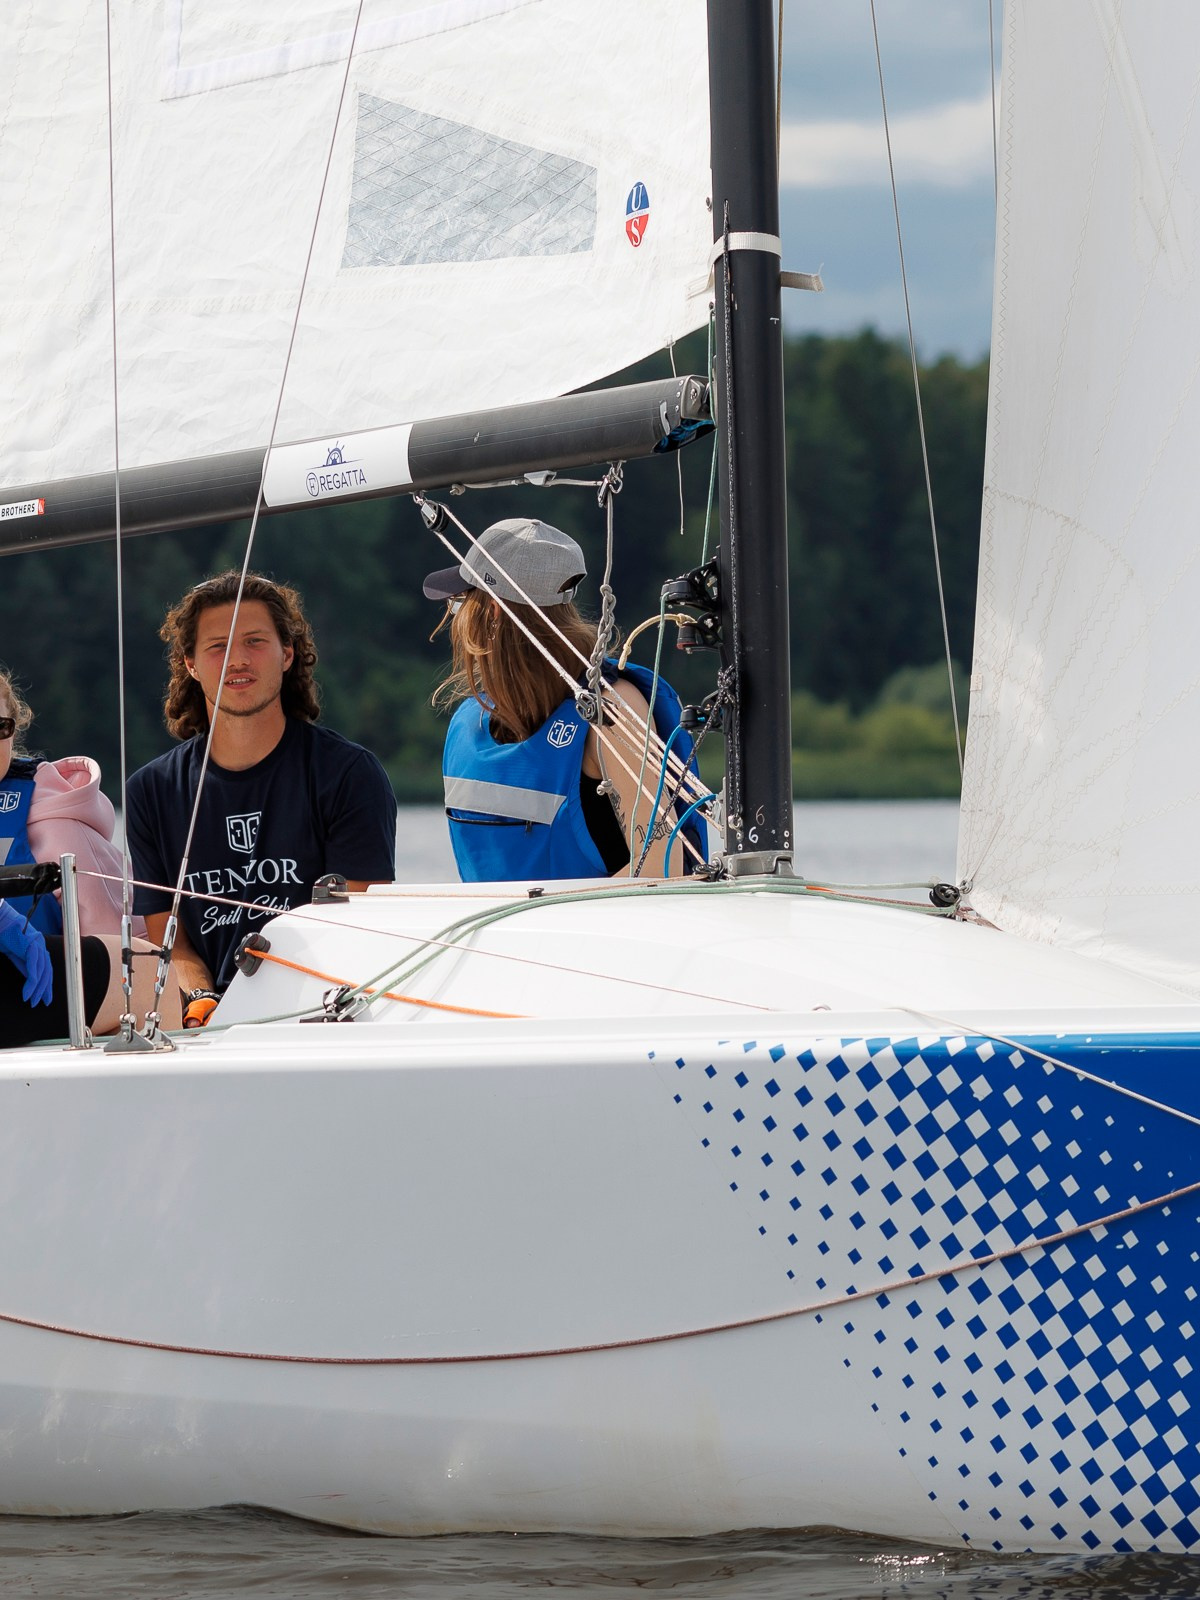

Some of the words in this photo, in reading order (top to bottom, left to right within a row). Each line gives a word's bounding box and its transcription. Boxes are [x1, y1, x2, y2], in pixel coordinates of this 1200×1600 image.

[319, 468, 367, 492] REGATTA
[1, 503, 35, 517] BROTHERS
[755, 804, 765, 826] 6
[748, 826, 759, 844] 6
